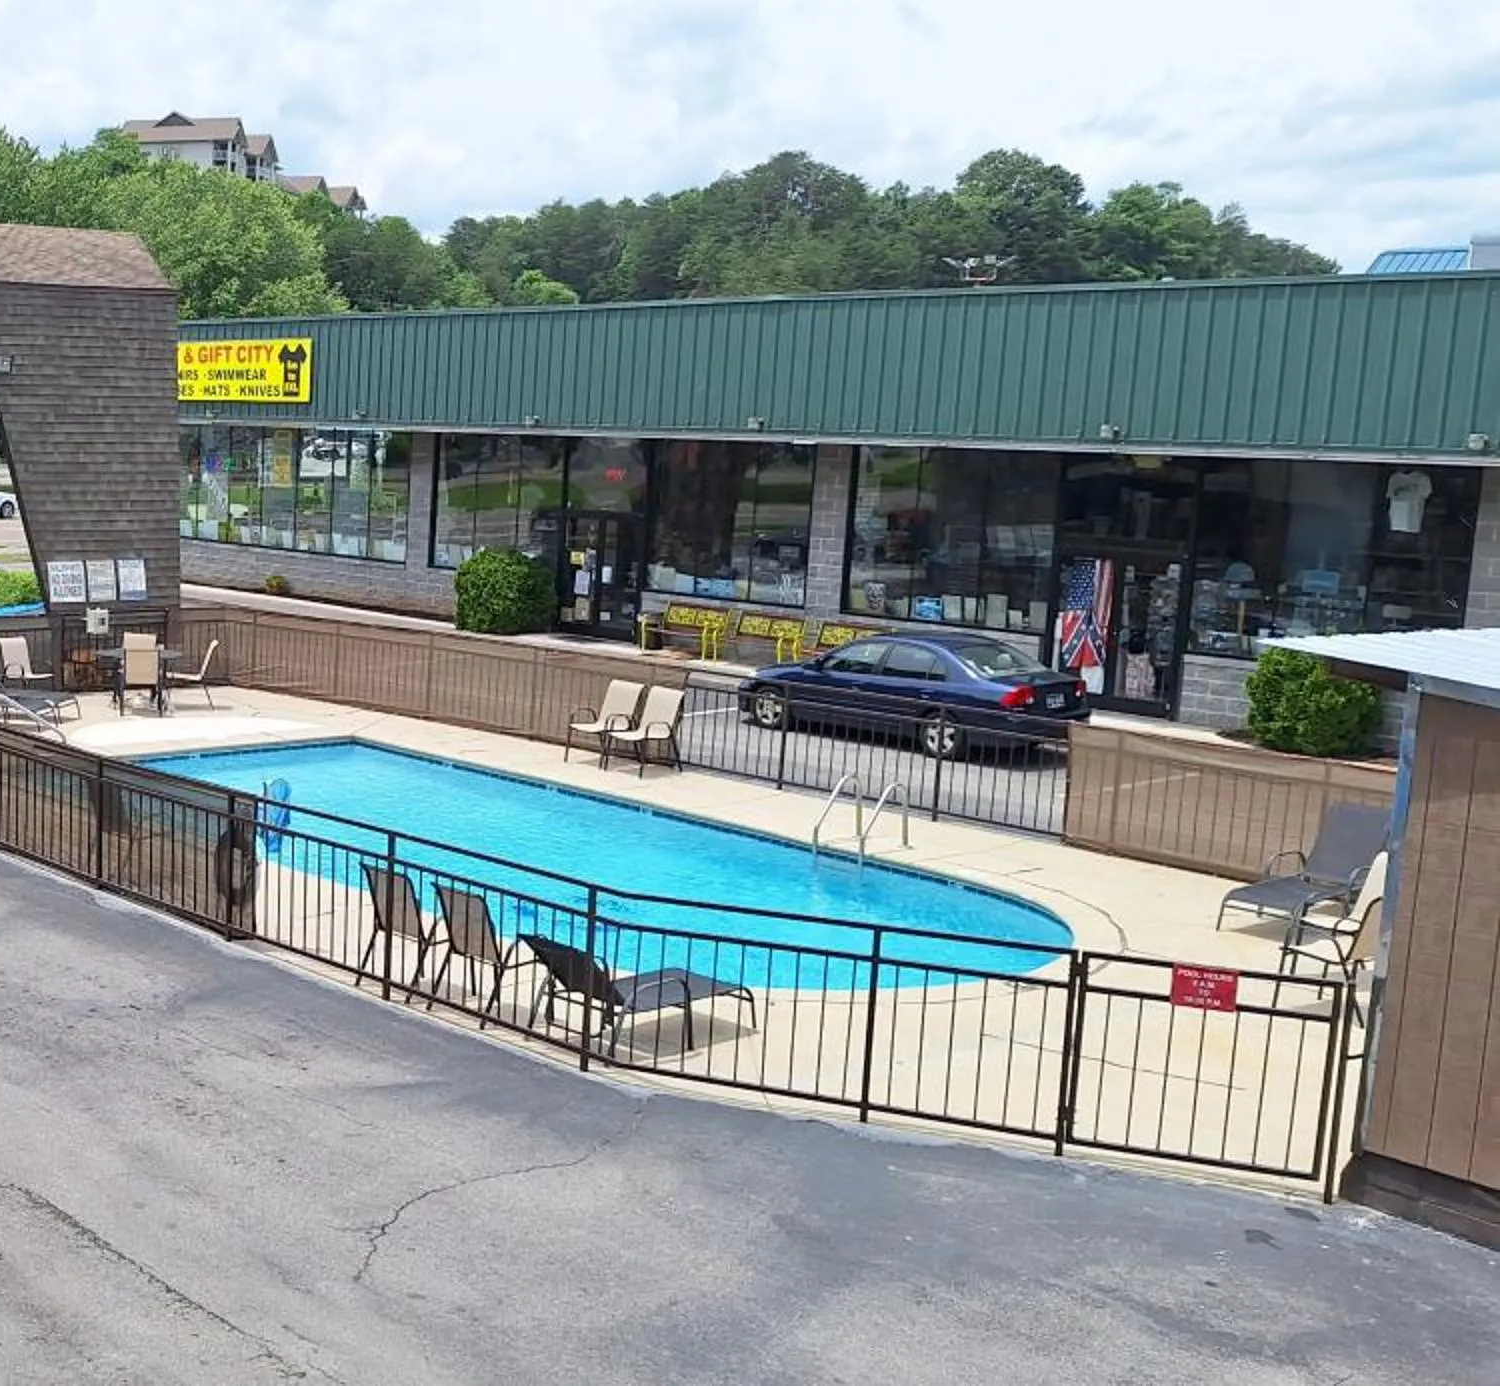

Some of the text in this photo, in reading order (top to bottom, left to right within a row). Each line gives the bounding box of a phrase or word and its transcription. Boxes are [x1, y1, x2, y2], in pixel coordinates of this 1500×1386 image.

[183, 345, 275, 364] & GIFT CITY
[203, 384, 231, 397] HATS
[239, 384, 281, 397] KNIVES
[1177, 968, 1202, 978] POOL
